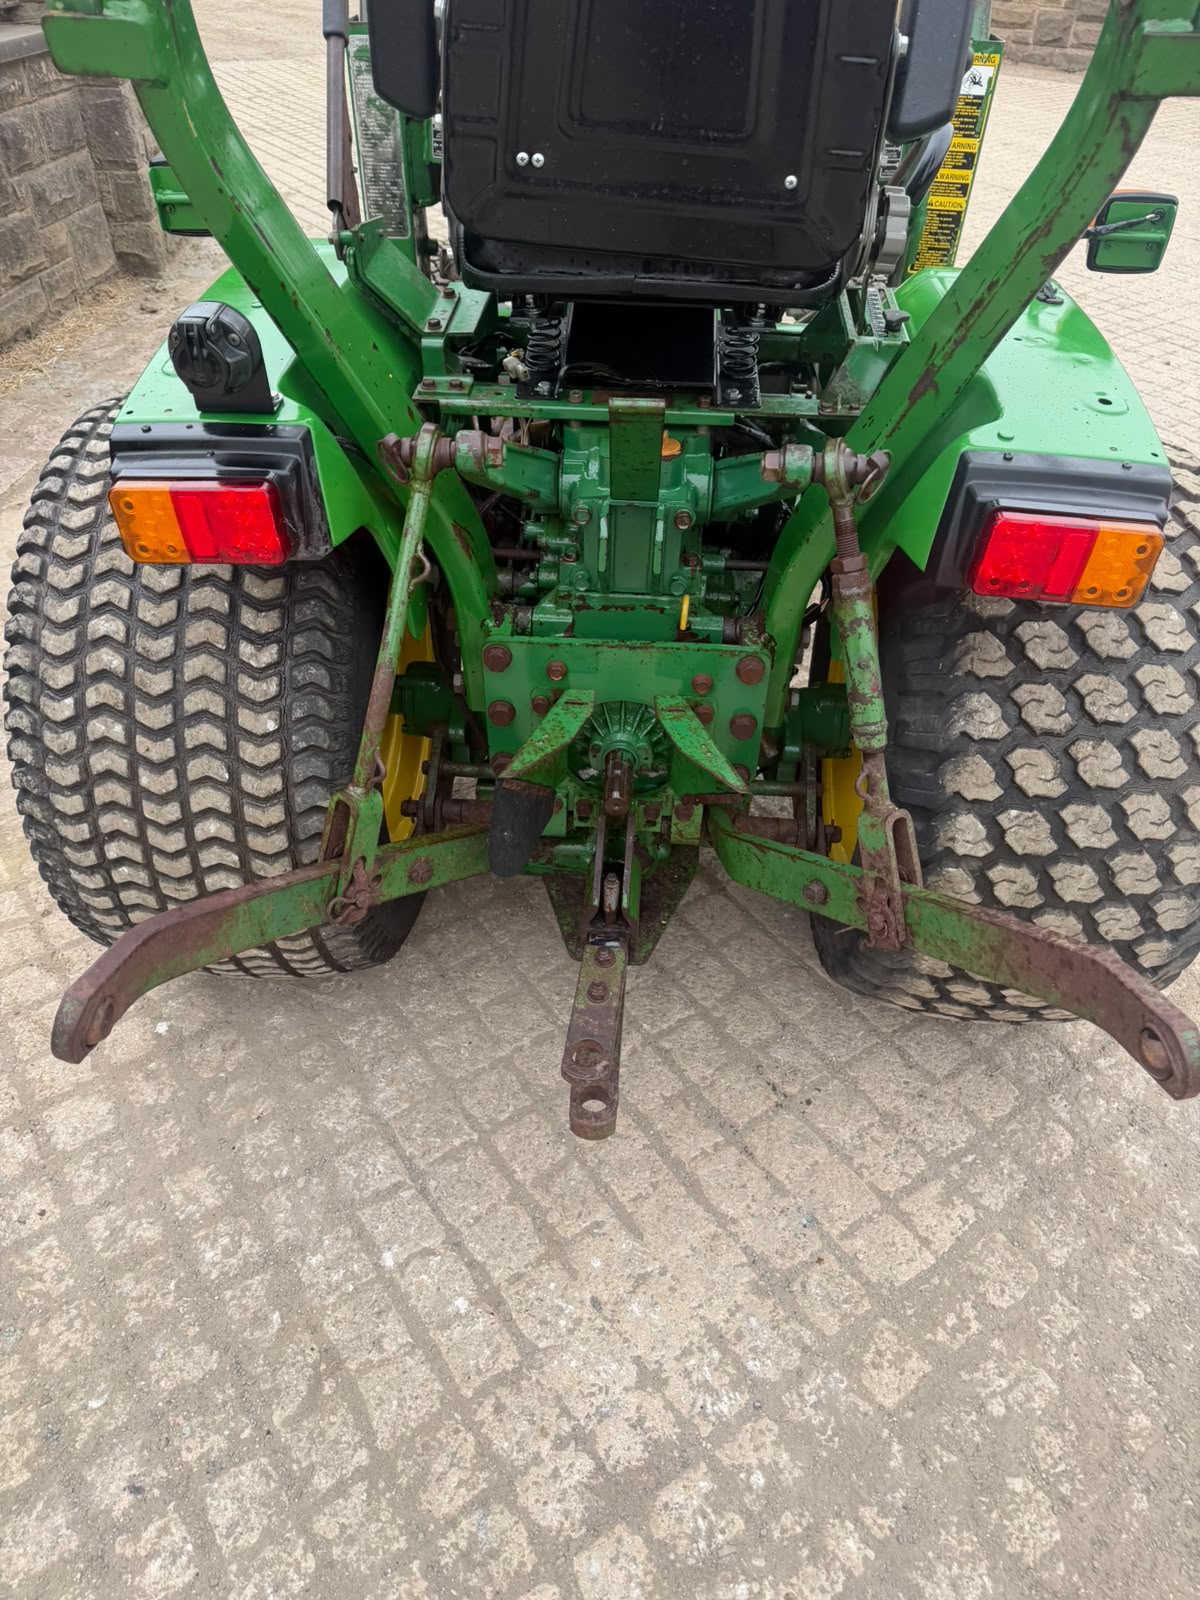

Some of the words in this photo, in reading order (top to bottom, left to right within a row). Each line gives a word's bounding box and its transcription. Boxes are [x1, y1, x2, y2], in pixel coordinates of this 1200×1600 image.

[952, 142, 977, 151] ARNING
[939, 172, 969, 182] WARNING
[934, 200, 963, 209] CAUTION
